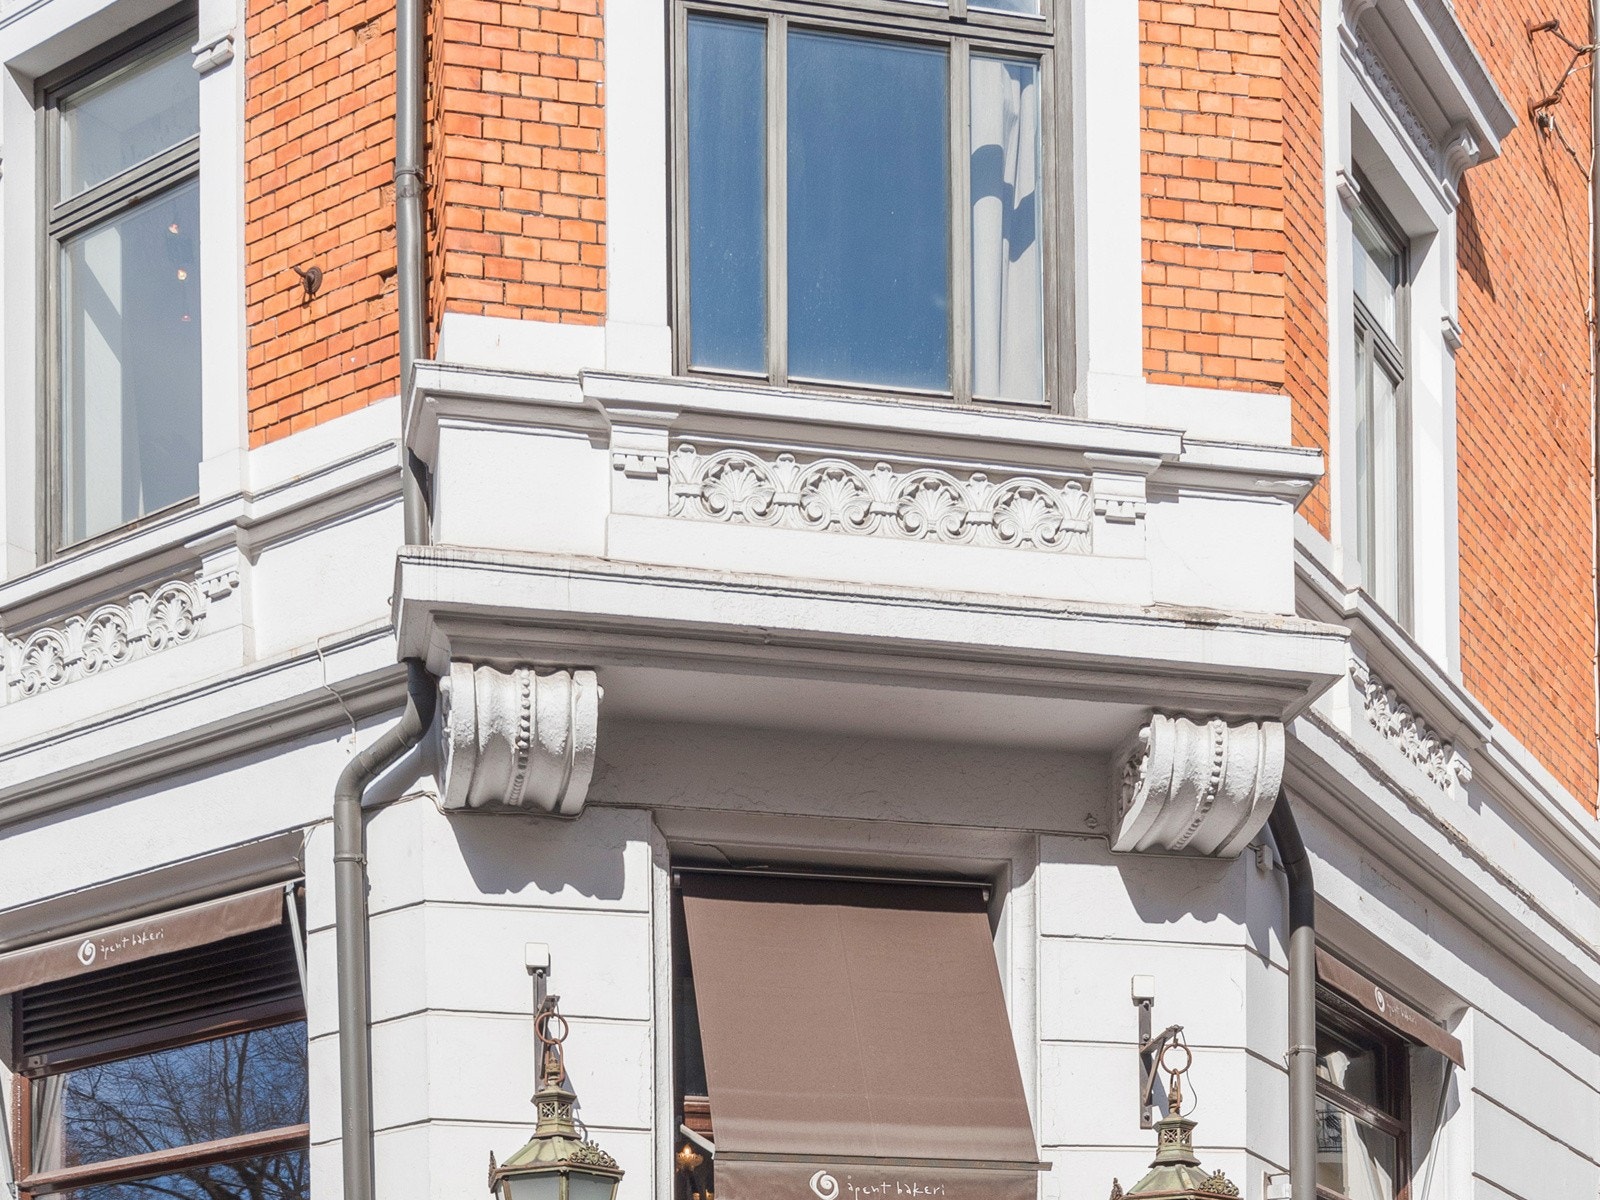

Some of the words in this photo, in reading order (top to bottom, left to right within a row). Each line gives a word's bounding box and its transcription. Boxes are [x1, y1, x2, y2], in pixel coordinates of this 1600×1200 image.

[100, 938, 130, 959] åpent
[132, 928, 165, 946] bakeri
[896, 1181, 946, 1198] bakeri
